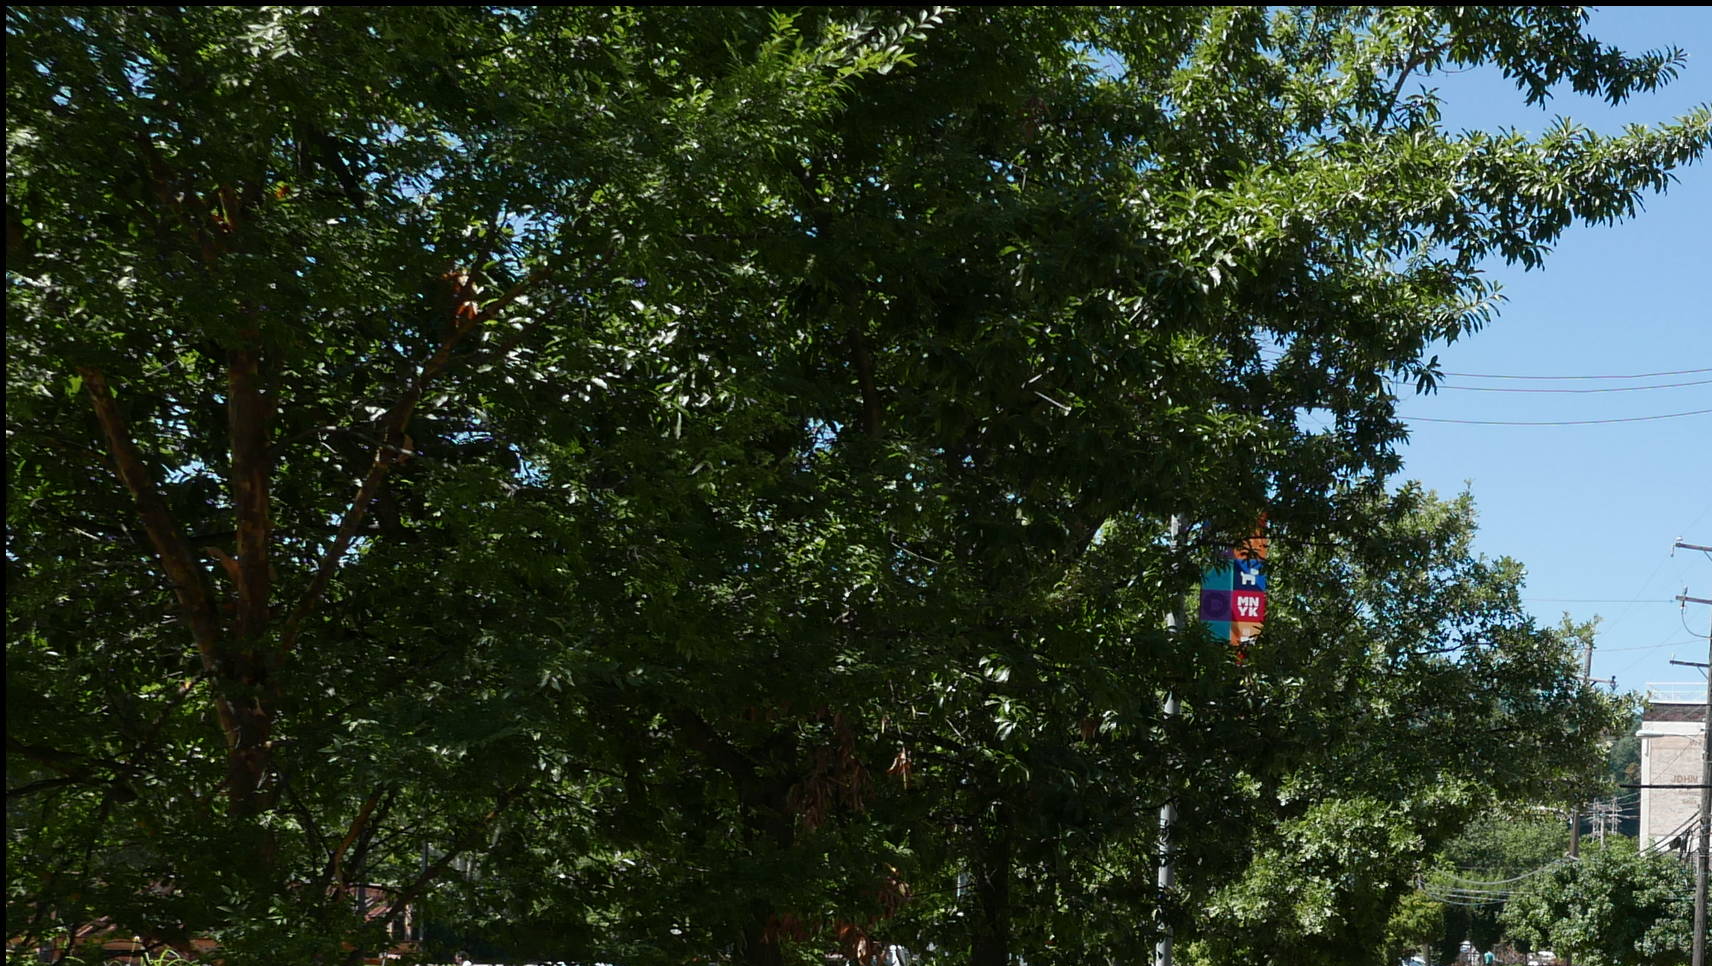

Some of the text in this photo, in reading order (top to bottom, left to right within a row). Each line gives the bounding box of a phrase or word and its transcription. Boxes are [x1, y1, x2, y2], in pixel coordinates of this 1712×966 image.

[1237, 596, 1260, 607] MN
[1238, 606, 1259, 617] YK
[1671, 775, 1698, 783] JOHN
